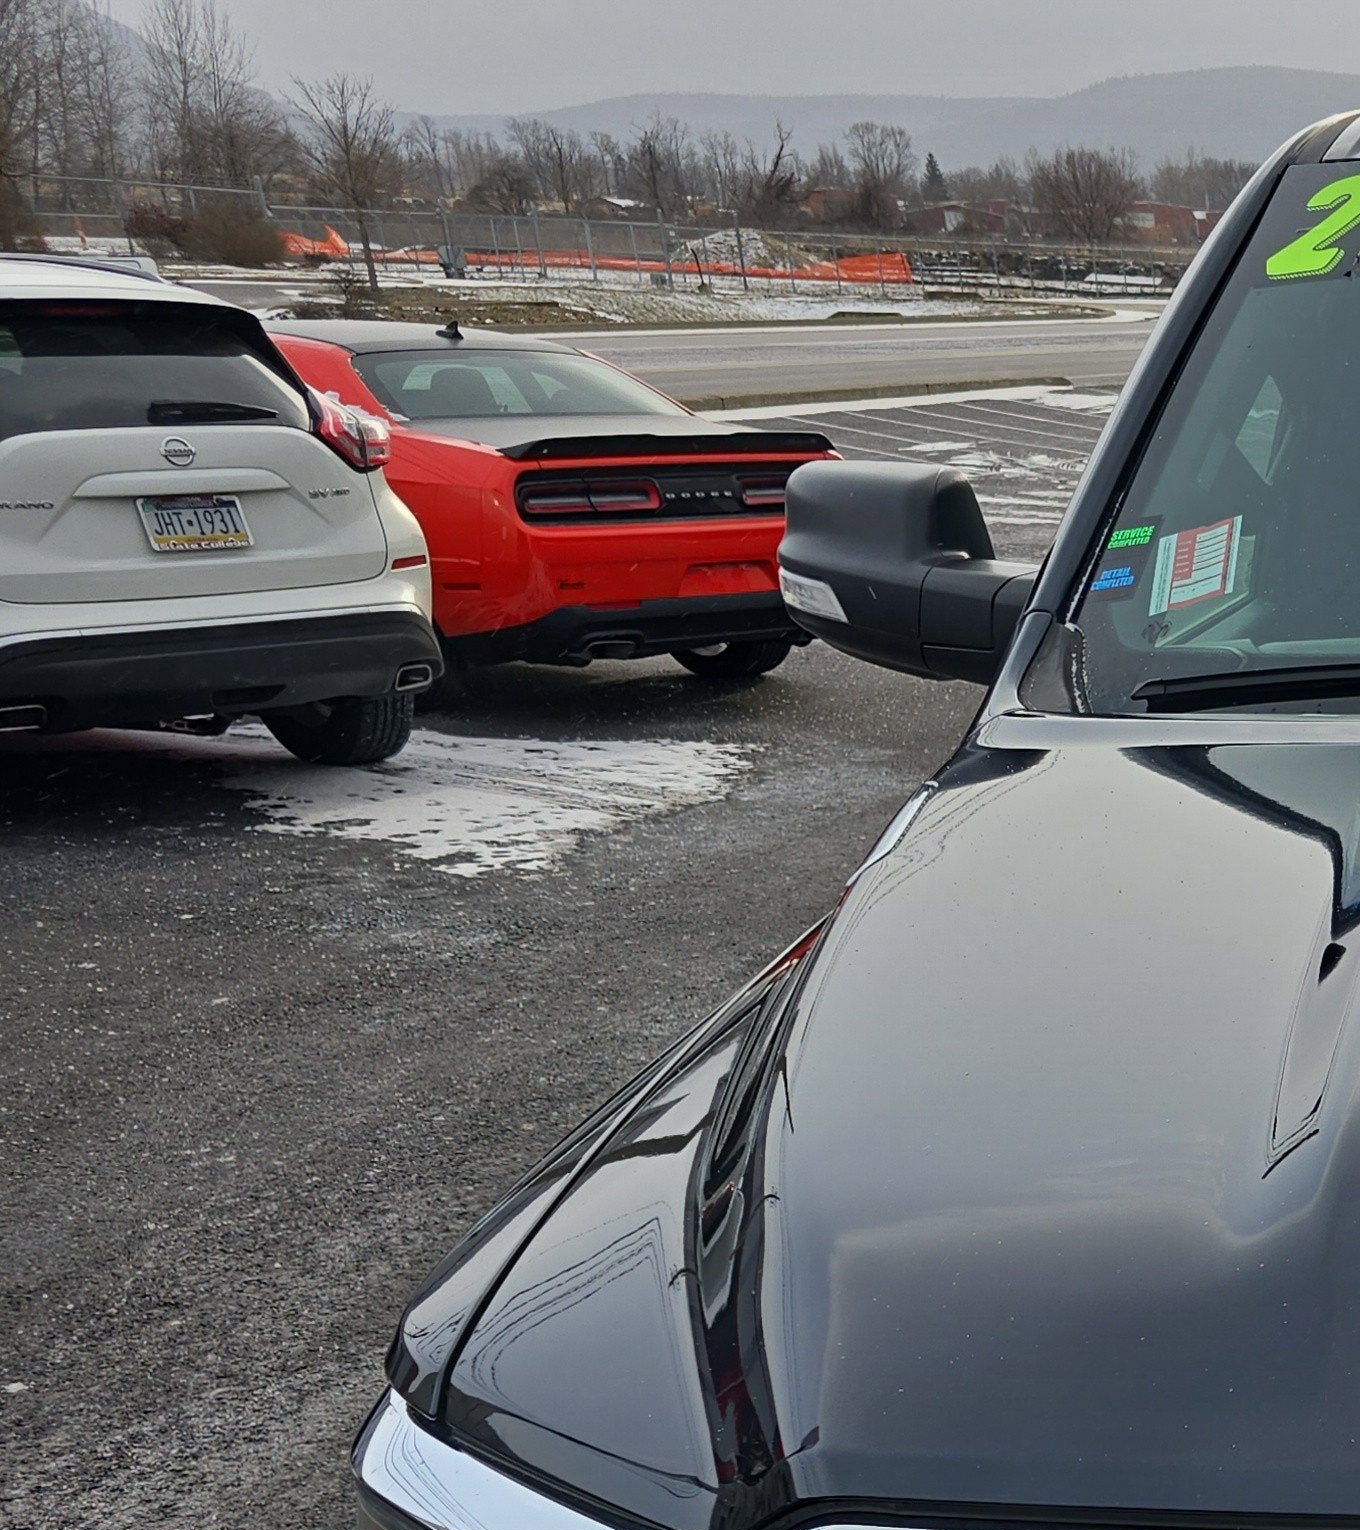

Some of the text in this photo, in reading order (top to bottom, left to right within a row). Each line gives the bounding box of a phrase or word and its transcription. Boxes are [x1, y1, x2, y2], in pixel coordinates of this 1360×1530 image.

[308, 486, 330, 499] SV
[665, 491, 733, 500] DODGE
[1110, 525, 1155, 541] SERVICE
[1107, 537, 1151, 550] COMPLETED
[1100, 566, 1131, 580] DETAIL
[1090, 575, 1135, 592] COMPLETED
